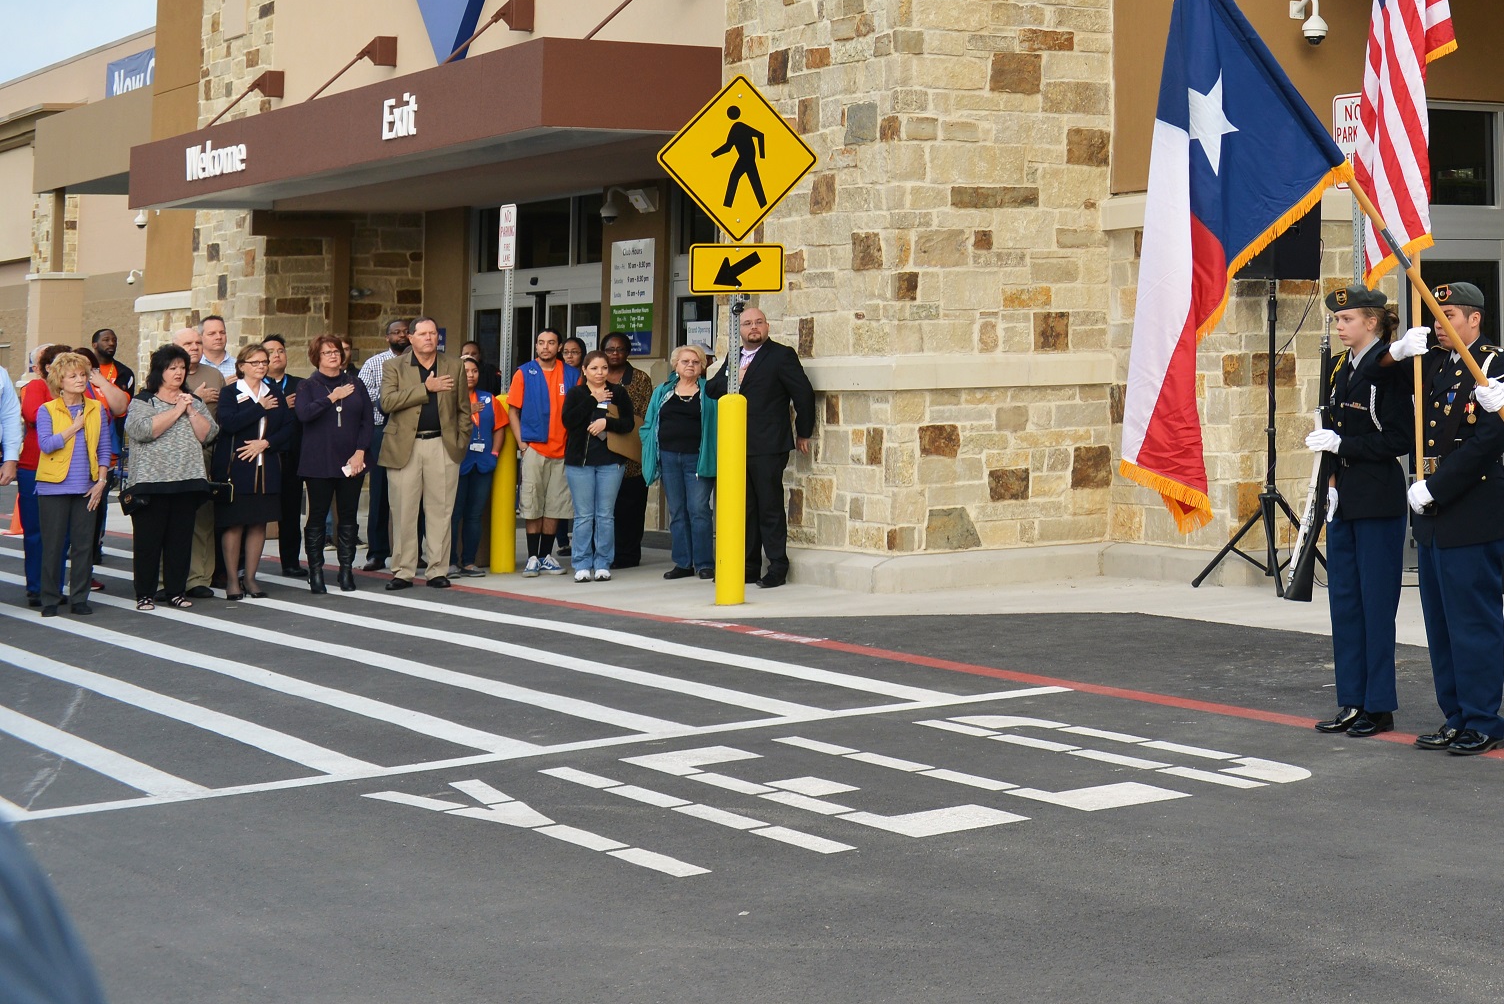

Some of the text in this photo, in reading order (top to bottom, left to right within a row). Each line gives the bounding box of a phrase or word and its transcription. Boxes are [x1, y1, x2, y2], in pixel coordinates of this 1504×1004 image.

[381, 92, 418, 141] Exit
[185, 140, 247, 181] Welcome
[360, 715, 1312, 877] YIELD
